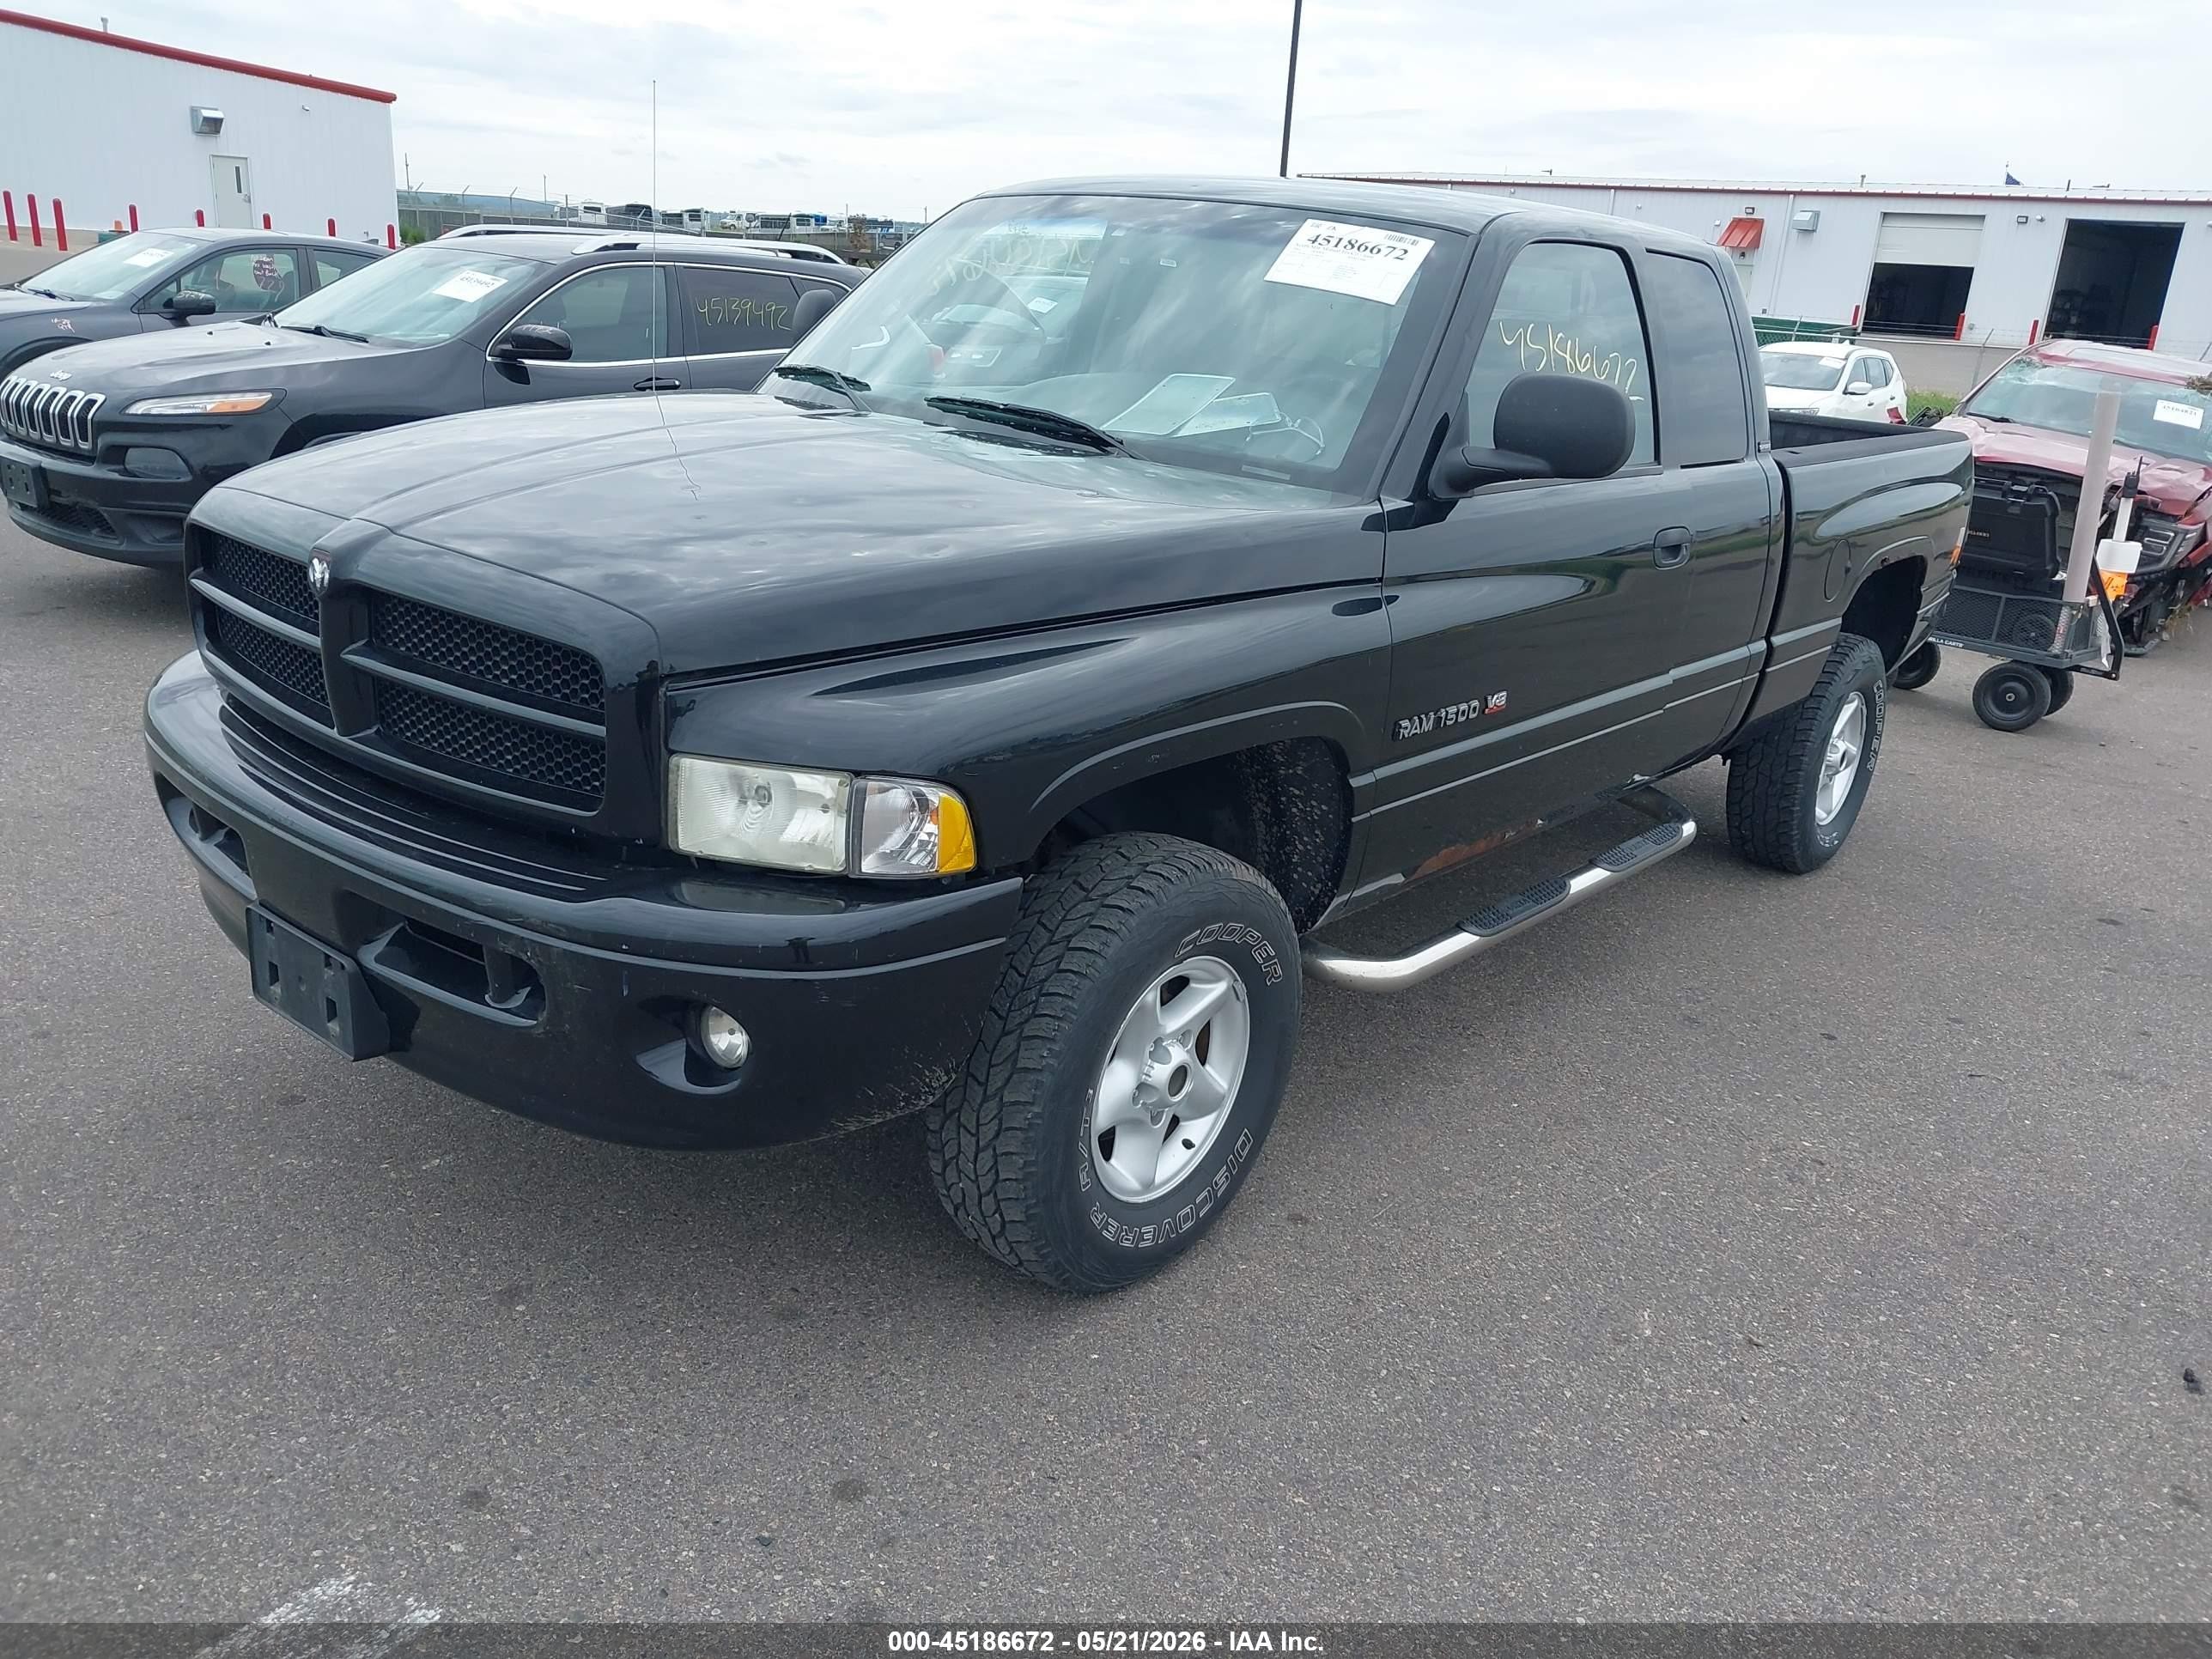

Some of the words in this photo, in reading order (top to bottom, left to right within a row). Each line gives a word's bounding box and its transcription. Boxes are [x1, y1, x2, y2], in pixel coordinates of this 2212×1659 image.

[1307, 234, 1408, 261] 45186672
[695, 296, 792, 331] 45139492
[1499, 321, 1645, 400] 45186672
[1395, 710, 1435, 740] RAM
[1433, 699, 1480, 728] 1500
[1485, 690, 1508, 712] V8
[1868, 679, 1885, 772] COOPER
[1174, 922, 1283, 987] COOPER
[1090, 1127, 1254, 1248] DISCOVERER
